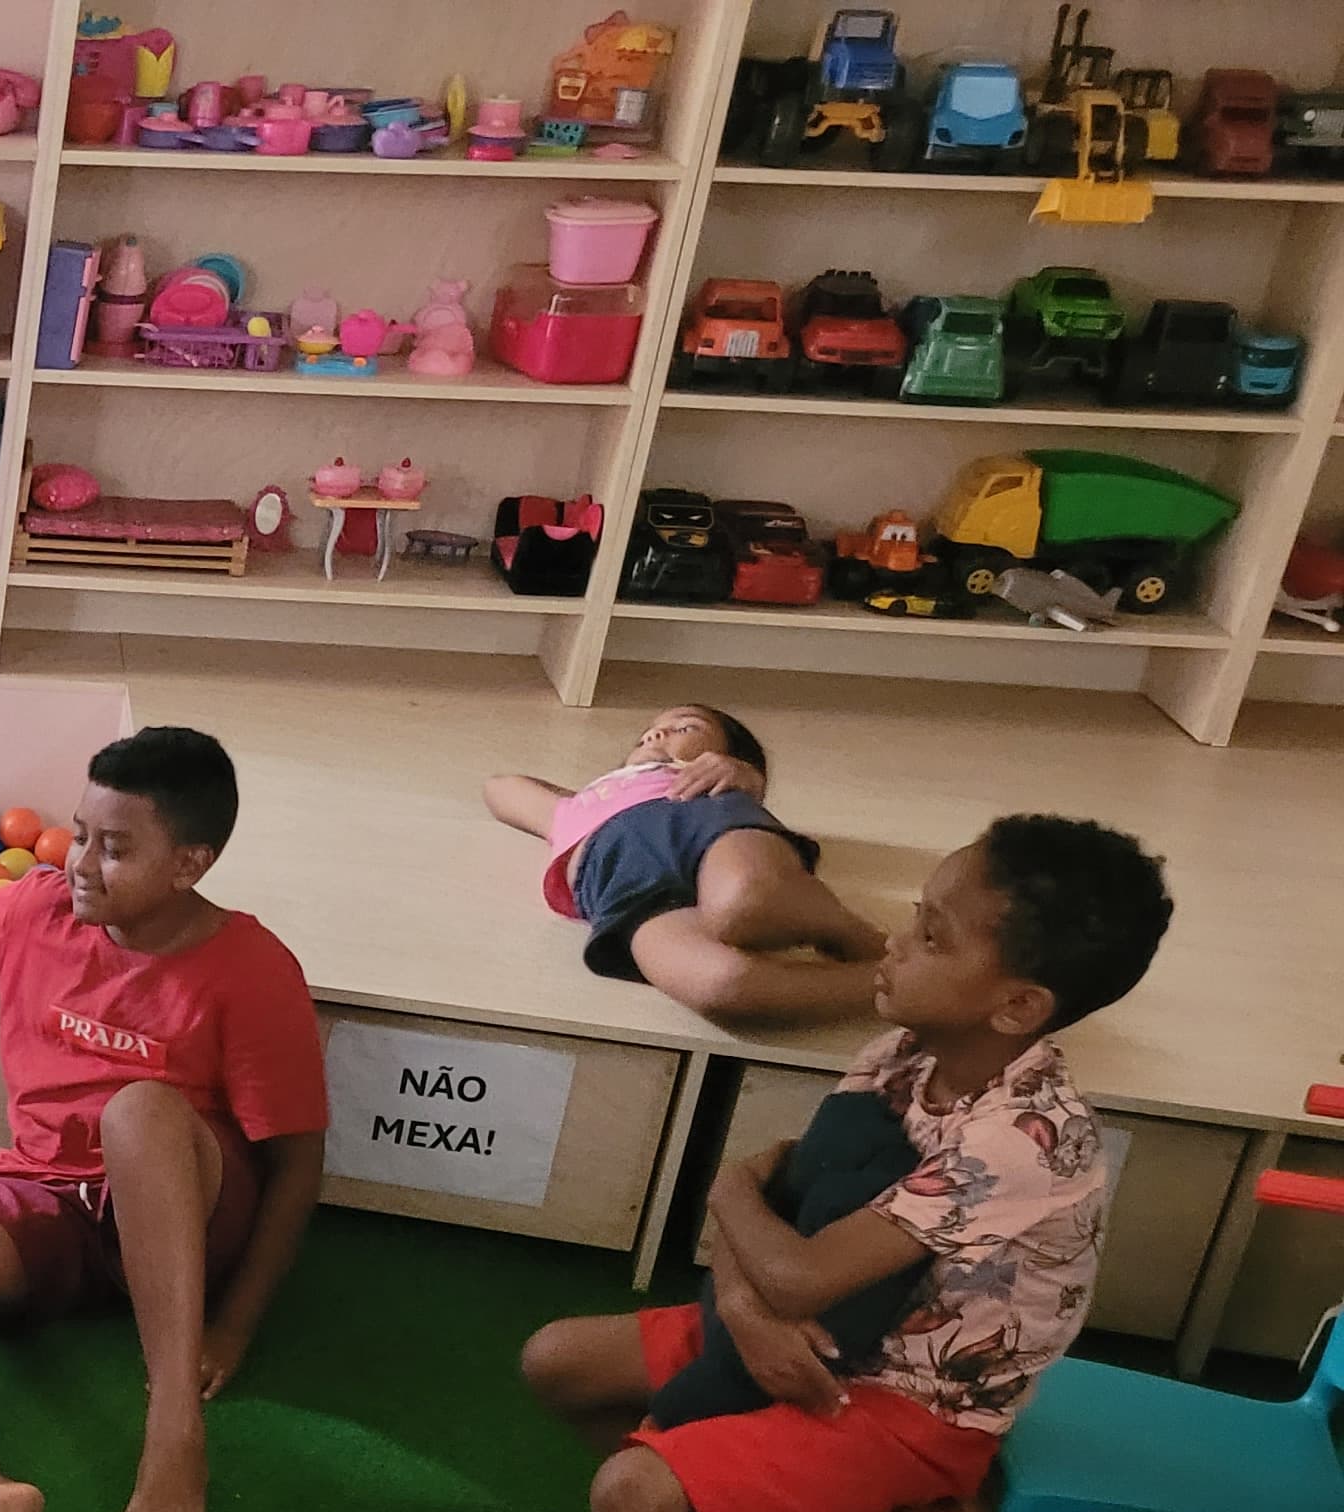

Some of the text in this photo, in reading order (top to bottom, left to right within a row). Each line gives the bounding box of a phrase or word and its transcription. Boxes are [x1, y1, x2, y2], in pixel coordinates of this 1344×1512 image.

[60, 1013, 150, 1059] PRADA
[399, 1066, 487, 1103] NÃO
[372, 1116, 496, 1156] MEXA!
